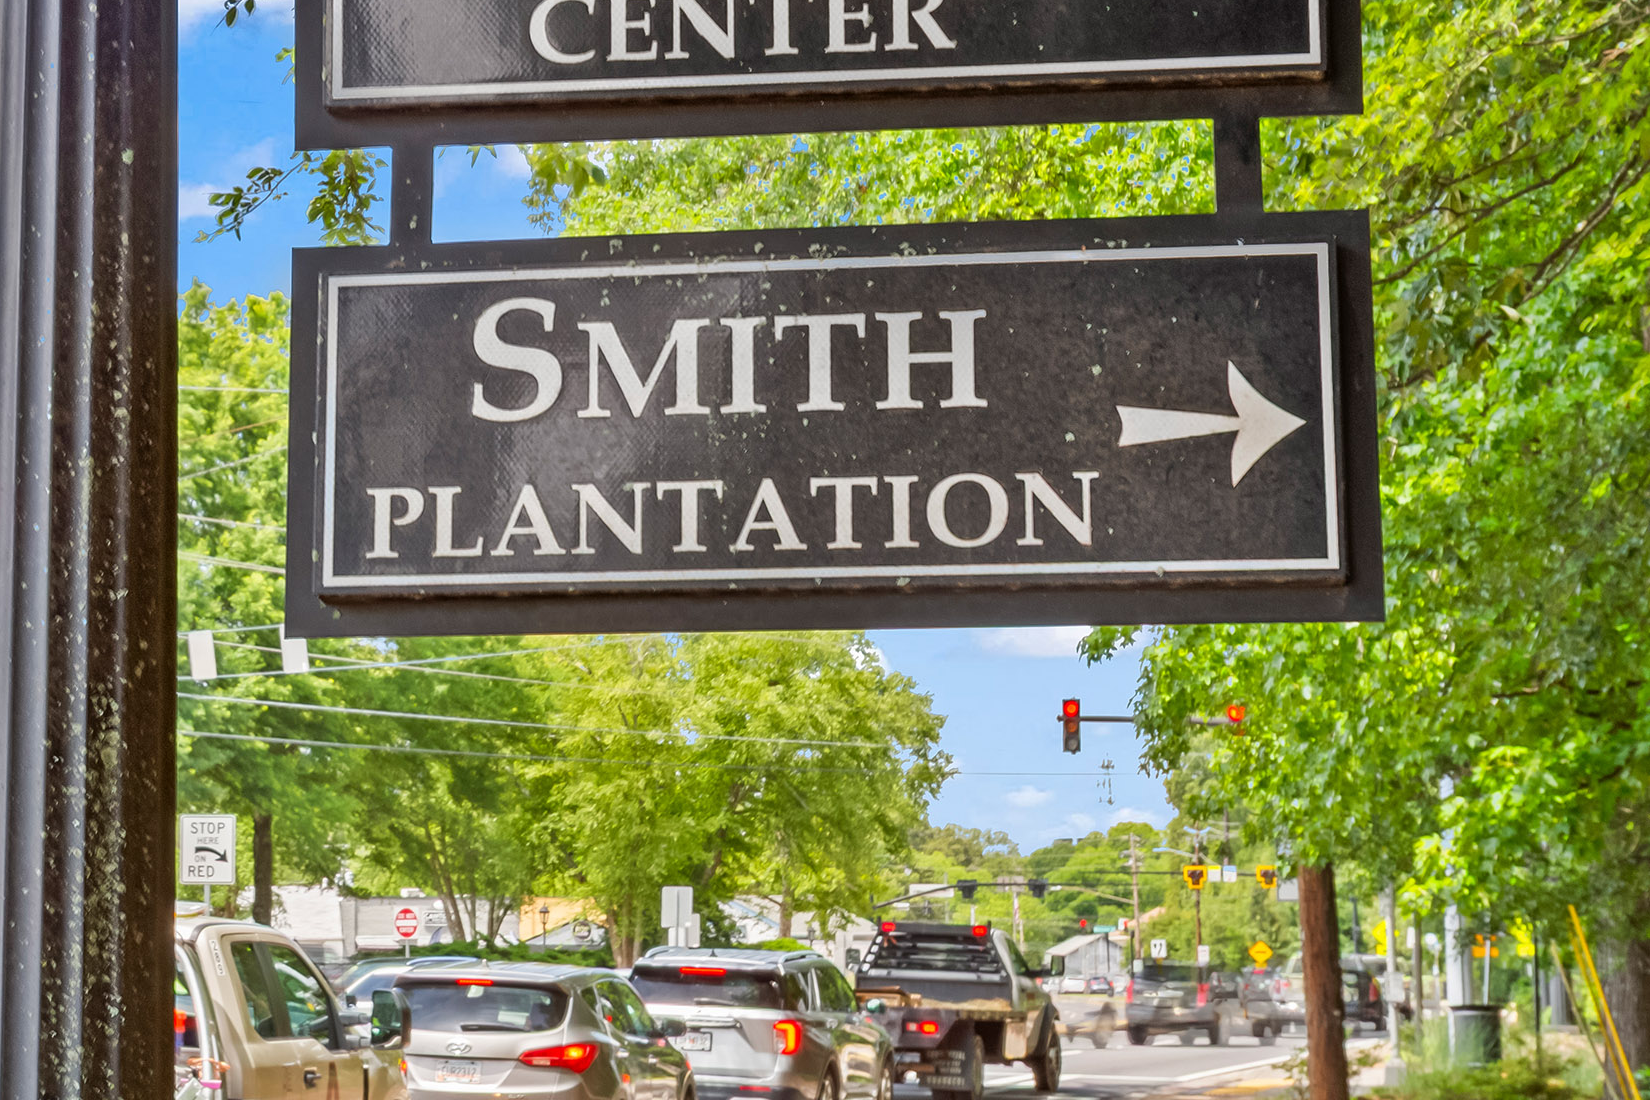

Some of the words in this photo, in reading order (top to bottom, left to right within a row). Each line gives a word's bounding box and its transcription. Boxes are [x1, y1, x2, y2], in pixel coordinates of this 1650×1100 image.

[471, 297, 988, 422] SMITH
[365, 471, 1100, 559] PLANTATION
[190, 822, 225, 834] STOP
[188, 865, 215, 877] RED
